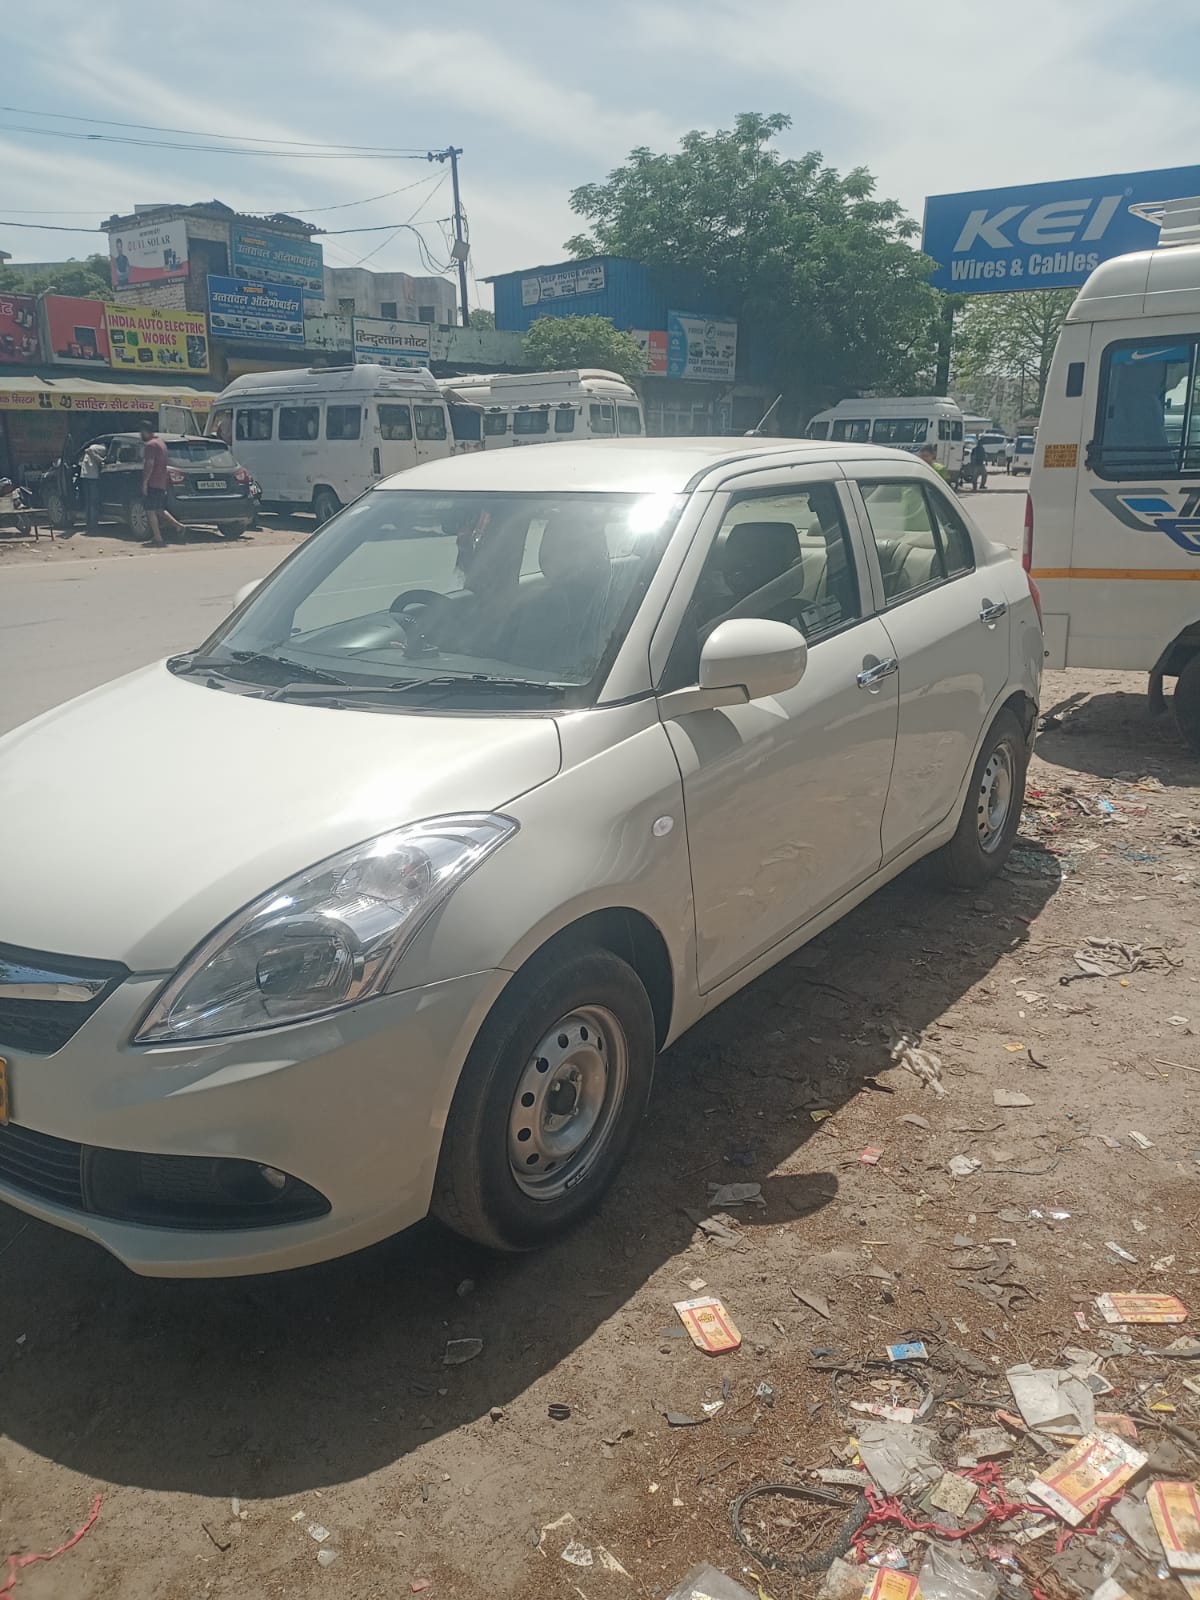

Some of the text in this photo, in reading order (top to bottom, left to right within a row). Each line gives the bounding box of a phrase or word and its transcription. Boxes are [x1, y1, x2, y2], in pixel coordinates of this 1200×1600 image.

[952, 195, 1123, 252] KEI
[952, 251, 1099, 280] Wires & Cables
[108, 314, 205, 334] INDIA AUTO ELECTRIC
[142, 331, 177, 346] WORKS
[356, 329, 428, 348] हिन्दुस्तान मोटर
[74, 396, 155, 410] साहिल सीट मेकर
